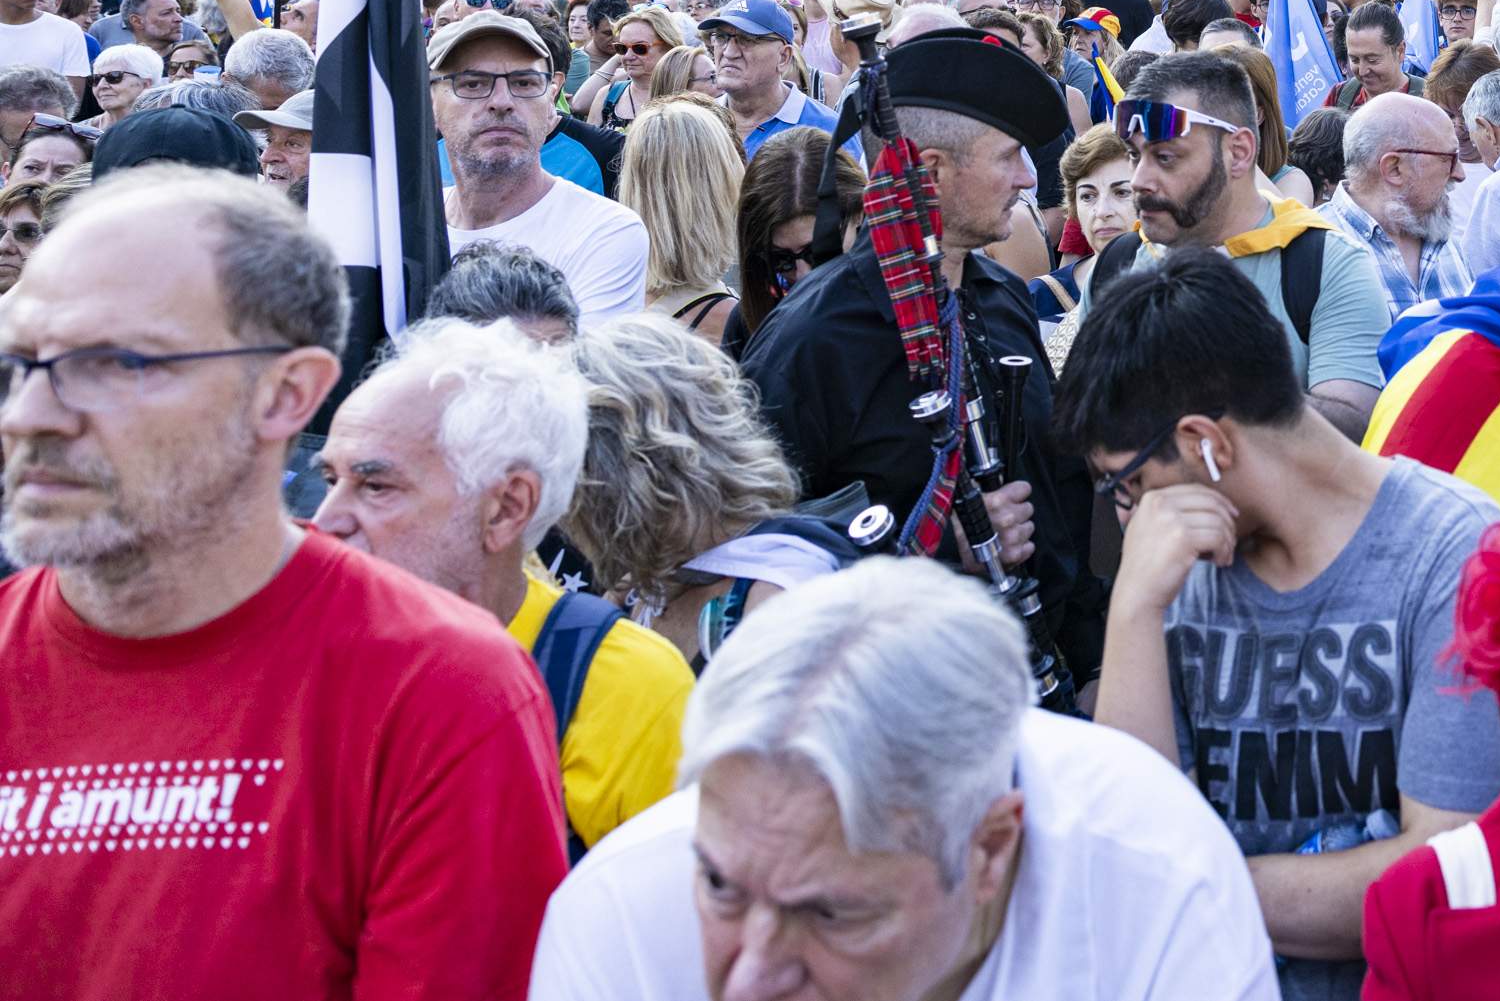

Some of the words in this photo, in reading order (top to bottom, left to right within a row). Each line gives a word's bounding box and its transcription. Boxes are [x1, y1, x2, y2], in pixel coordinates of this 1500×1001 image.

[1165, 622, 1395, 723] GUESS
[25, 781, 55, 831] i
[50, 773, 243, 830] amunt!
[1196, 727, 1402, 821] ENIM
